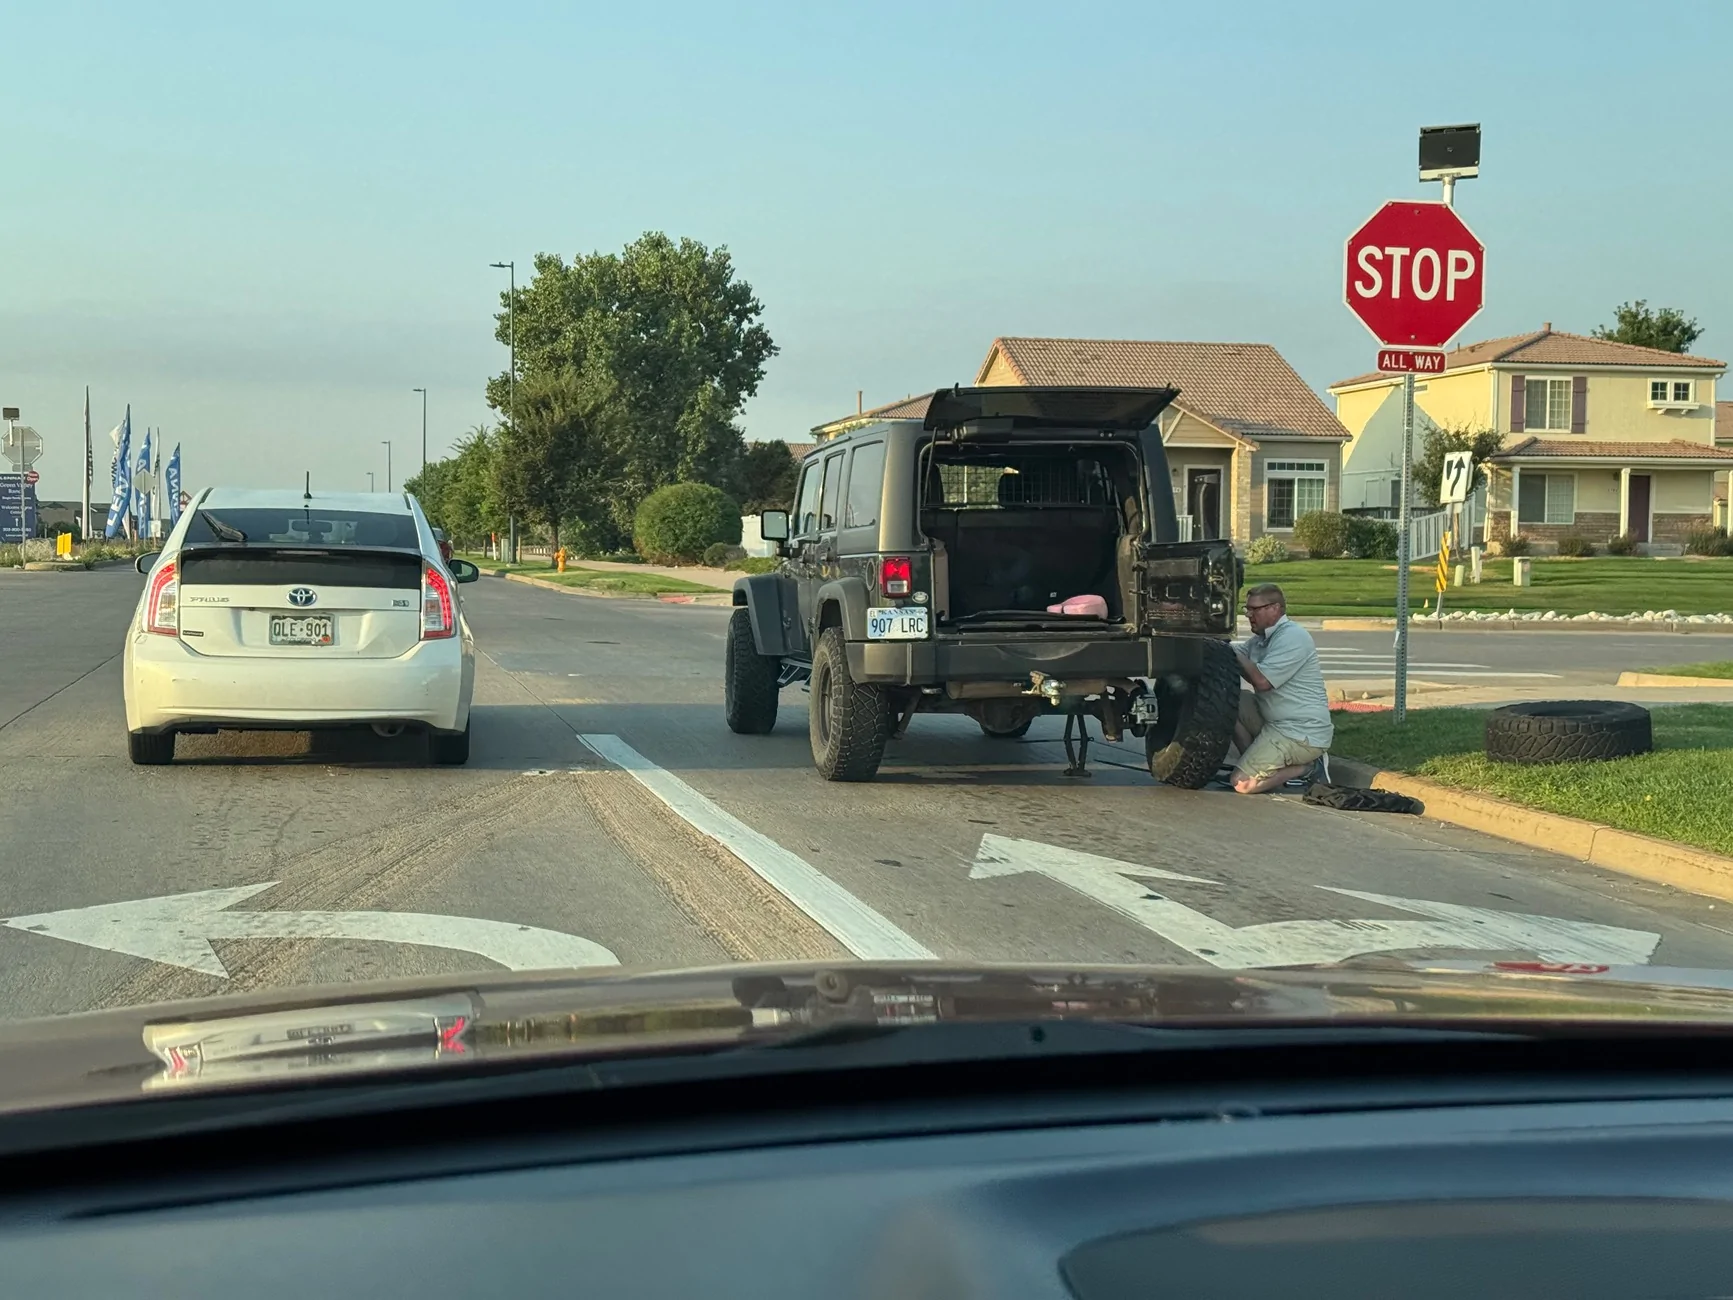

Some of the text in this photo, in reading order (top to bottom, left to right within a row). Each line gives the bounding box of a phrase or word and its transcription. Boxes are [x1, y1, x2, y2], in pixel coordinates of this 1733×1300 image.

[1354, 245, 1476, 302] STOP
[1382, 354, 1441, 370] ALL WAY
[871, 617, 924, 633] 907 LRC
